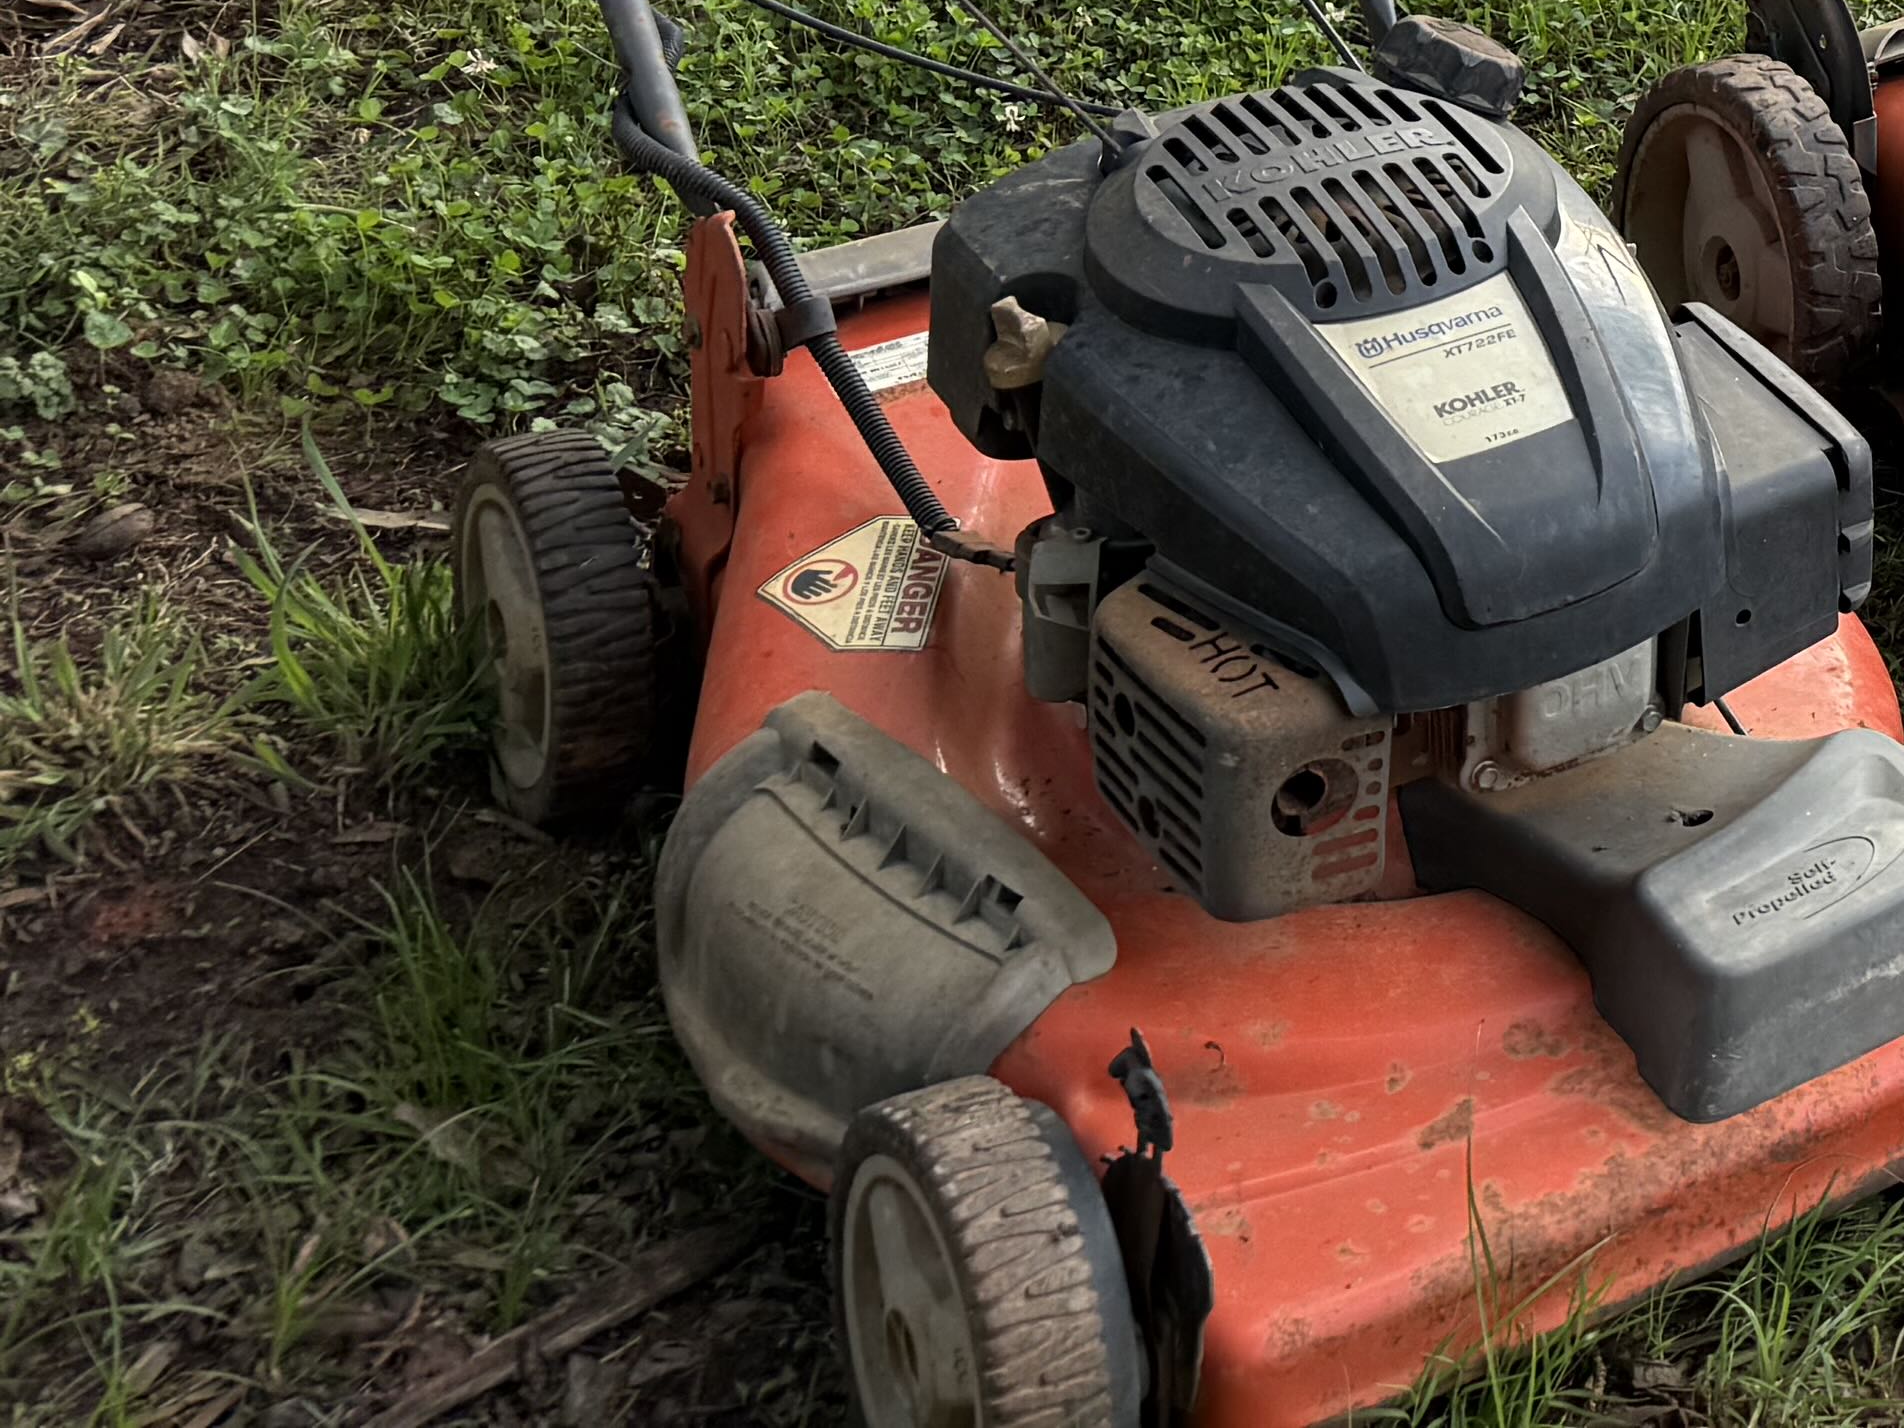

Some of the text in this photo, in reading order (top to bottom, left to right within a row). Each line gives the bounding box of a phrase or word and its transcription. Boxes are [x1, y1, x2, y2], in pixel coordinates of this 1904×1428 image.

[1201, 127, 1456, 203] KOHLER
[1383, 305, 1503, 349] Husqvarna
[1443, 329, 1517, 359] XT722FE
[1433, 381, 1521, 418] KOHLER
[870, 524, 916, 641] KEEP HANDS AND FEET AWAY
[1188, 630, 1280, 698] HOT
[1543, 653, 1638, 721] OHV
[1733, 871, 1836, 926] Propelled
[1787, 859, 1837, 885] Self-
